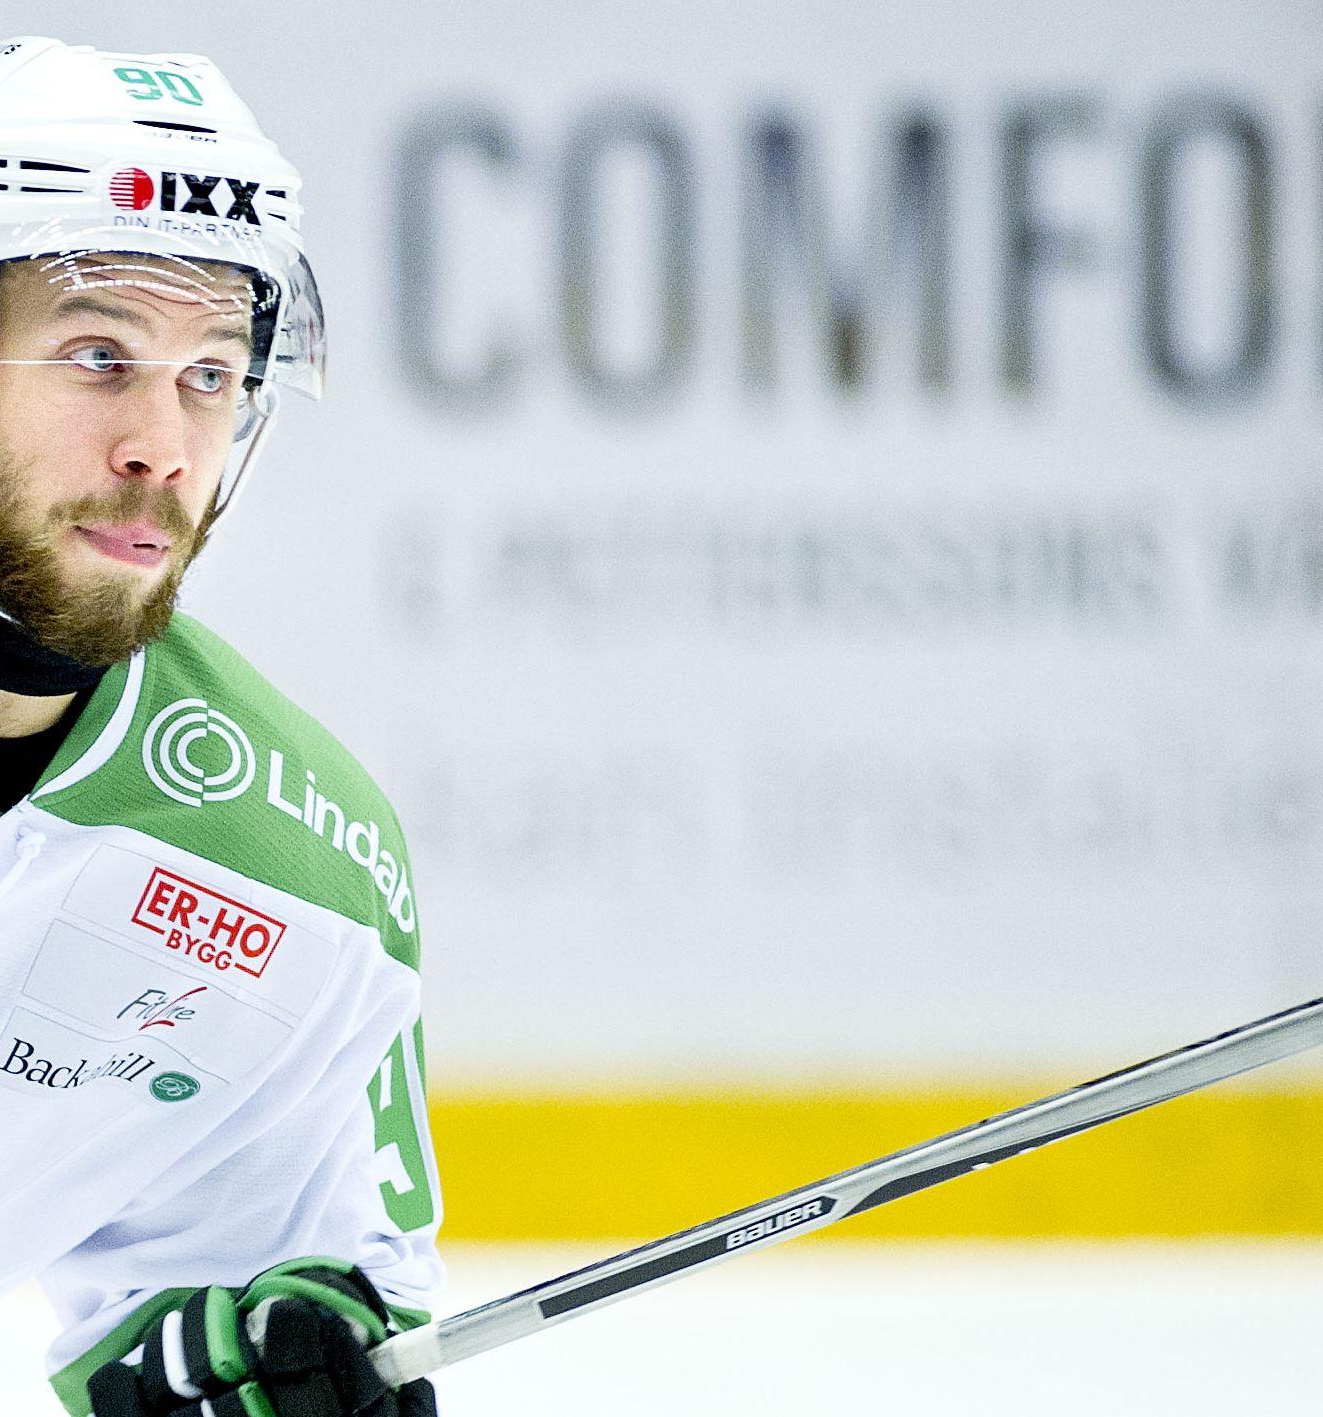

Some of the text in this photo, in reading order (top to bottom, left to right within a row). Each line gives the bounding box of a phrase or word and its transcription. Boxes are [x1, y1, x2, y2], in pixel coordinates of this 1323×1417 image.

[113, 67, 204, 106] 90
[160, 171, 262, 226] IXX
[386, 90, 1323, 412] COMFO
[267, 749, 416, 934] Lindab
[146, 880, 272, 959] ER-HO
[165, 928, 234, 971] BYGG
[366, 1014, 435, 1234] 9
